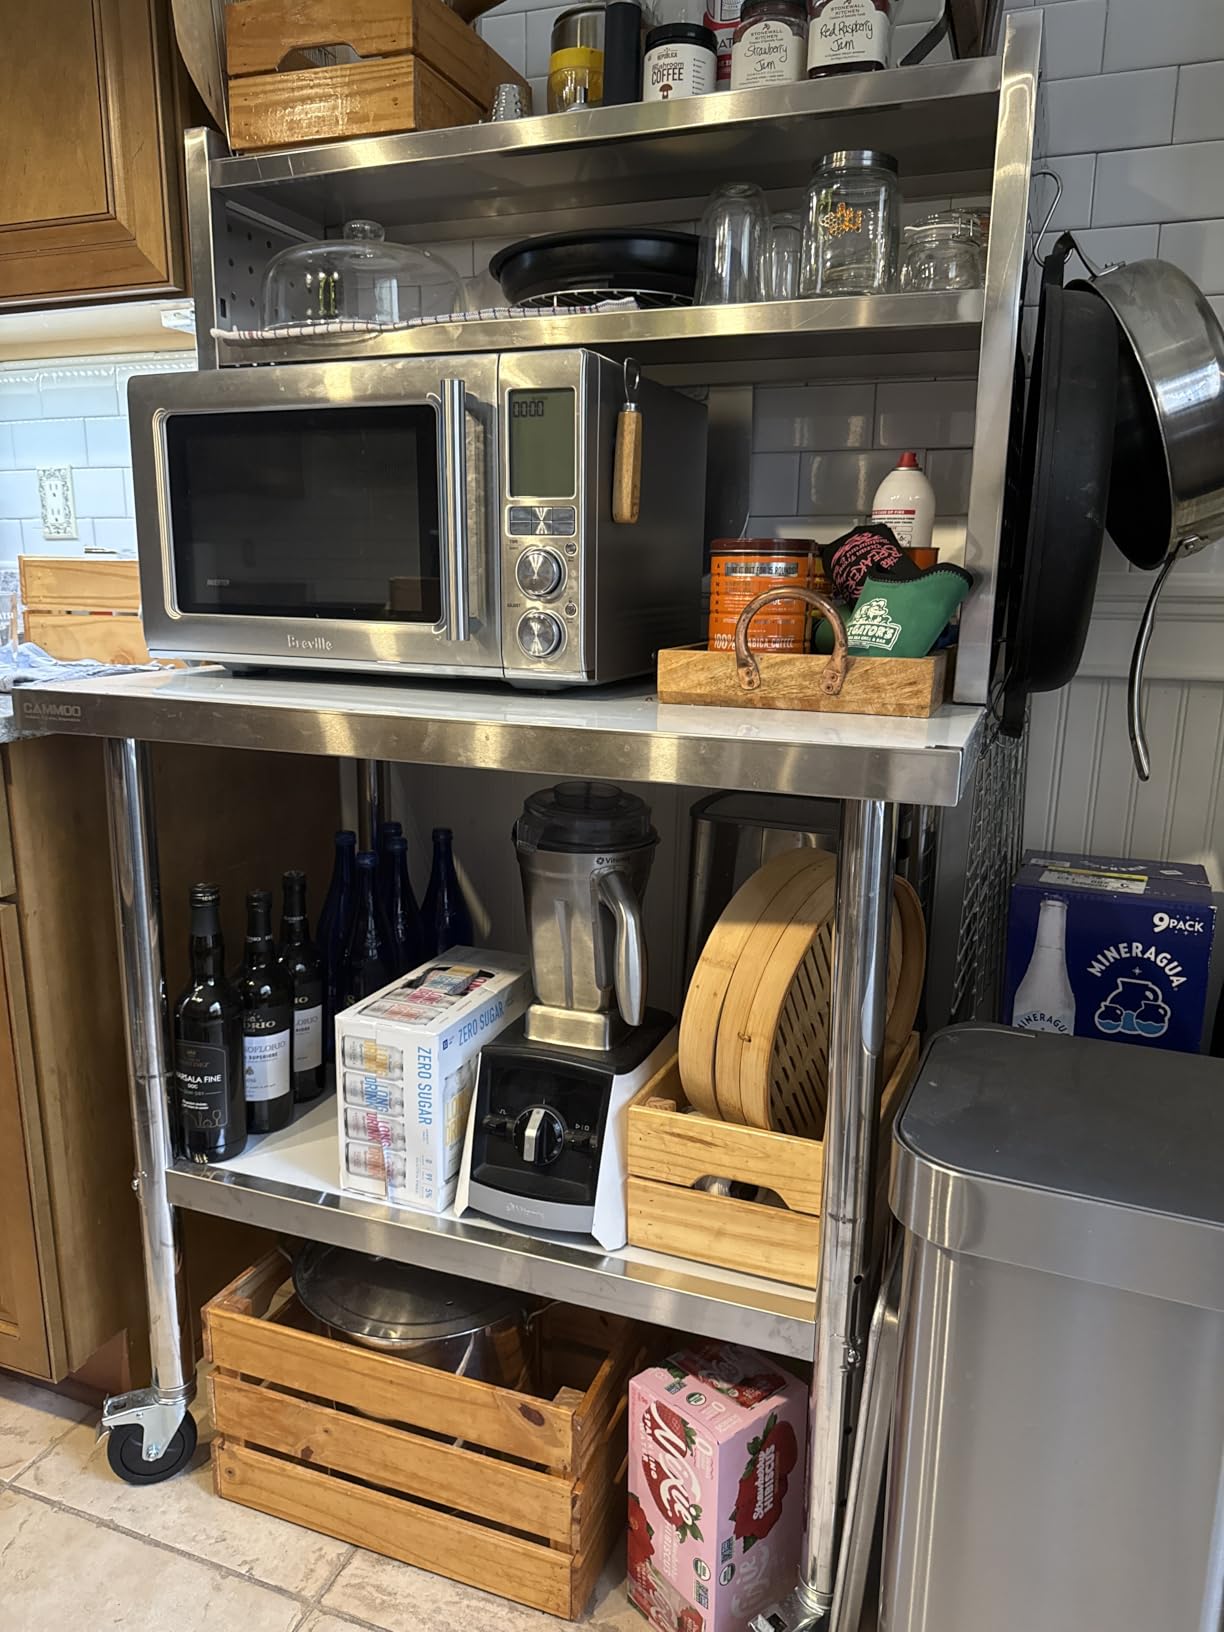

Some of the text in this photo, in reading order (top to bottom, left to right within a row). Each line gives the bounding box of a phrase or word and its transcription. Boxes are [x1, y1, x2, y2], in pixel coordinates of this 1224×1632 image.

[820, 22, 838, 38] Red
[830, 37, 855, 52] Jam
[744, 43, 788, 63] Strawberry
[754, 59, 776, 72] Jam
[652, 68, 684, 86] COFFEE
[287, 634, 333, 650] Breville
[1152, 912, 1204, 934] 9 PACK
[1087, 942, 1187, 988] MINERAGUA
[458, 1001, 505, 1046] ZERO SUGAR
[417, 1046, 432, 1079] ZERO
[204, 1074, 222, 1083] FINE
[364, 1075, 377, 1109] DRINK
[377, 1084, 389, 1113] LONG
[417, 1083, 433, 1126] SUGAR
[366, 1112, 380, 1142] DRINK
[650, 1401, 701, 1525] Nixie
[753, 1450, 766, 1520] Strawberry
[763, 1444, 776, 1513] HIBISCUS
